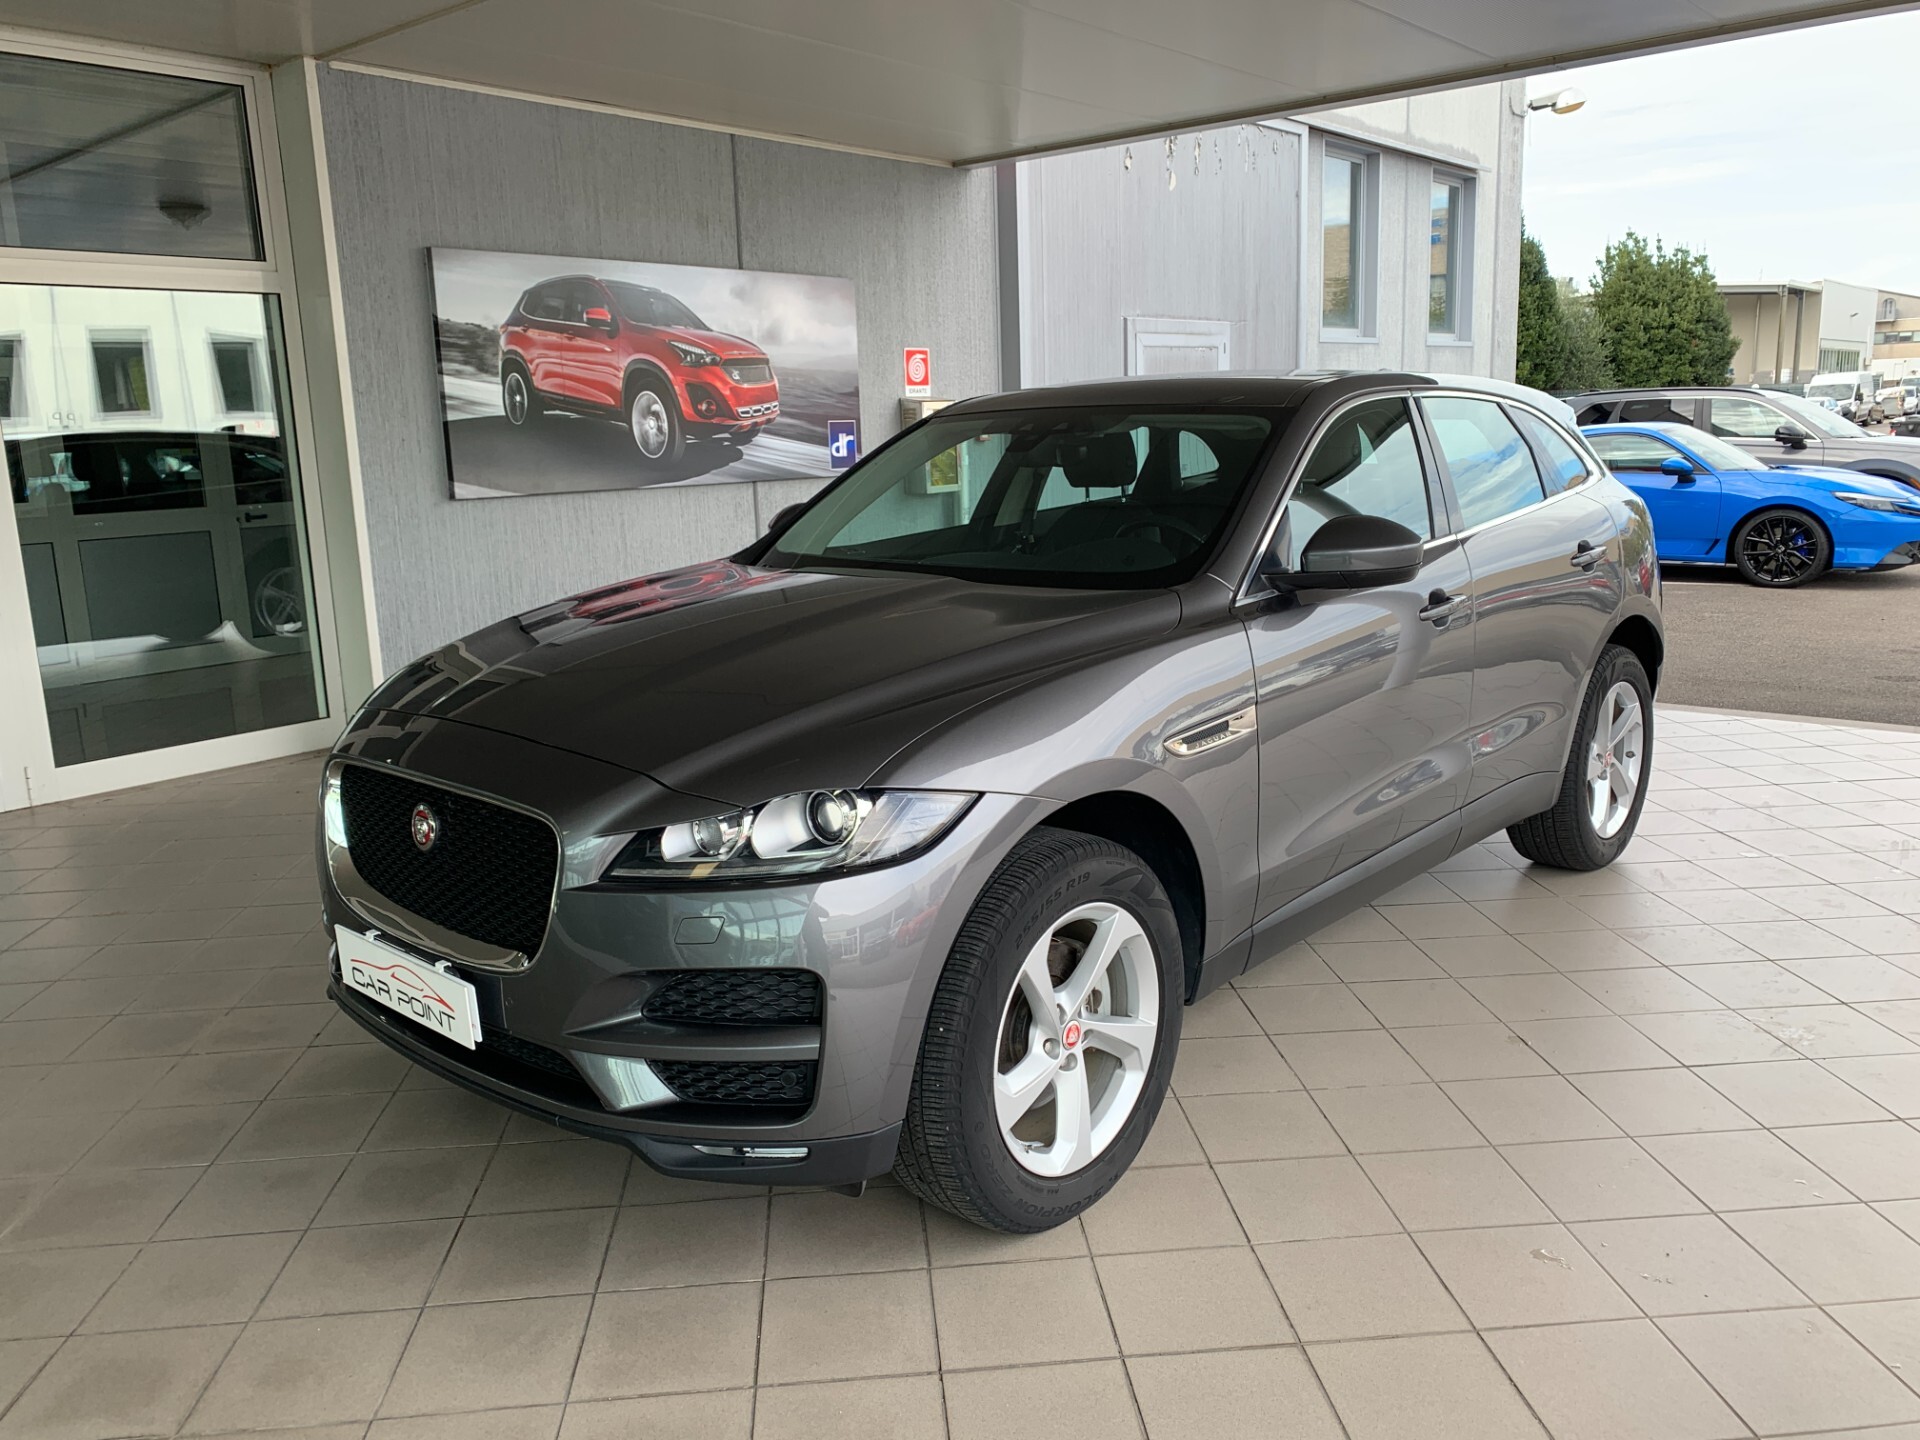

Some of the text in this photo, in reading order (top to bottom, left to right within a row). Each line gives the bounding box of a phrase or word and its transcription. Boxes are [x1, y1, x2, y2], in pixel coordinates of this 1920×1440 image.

[831, 432, 854, 457] dr
[1195, 731, 1233, 749] JAGUAR
[1065, 871, 1091, 892] R19
[351, 966, 456, 1032] CAR POINT
[1014, 1183, 1104, 1218] SCORPION
